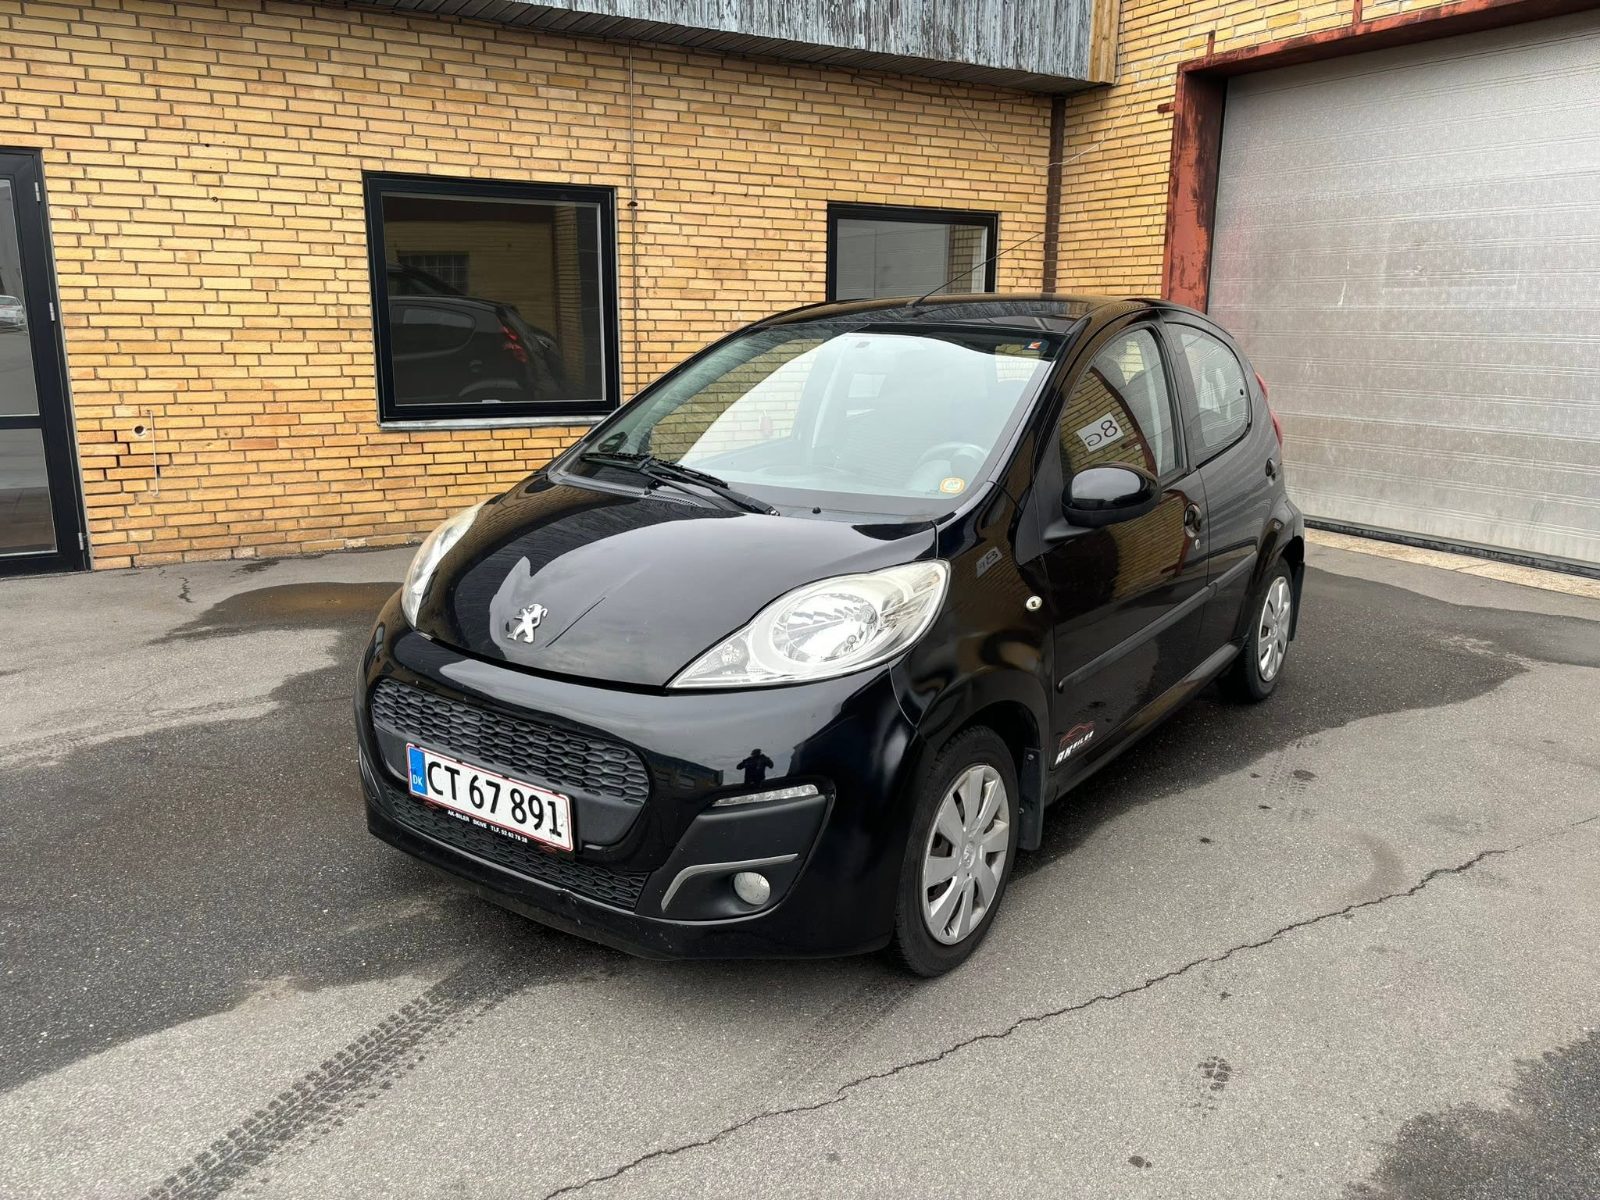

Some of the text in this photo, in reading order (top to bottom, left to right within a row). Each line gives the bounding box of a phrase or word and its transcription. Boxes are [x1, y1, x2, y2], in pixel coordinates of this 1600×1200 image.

[413, 774, 423, 787] DK
[427, 761, 562, 838] CT 67 891
[447, 810, 470, 822] AK-BILER
